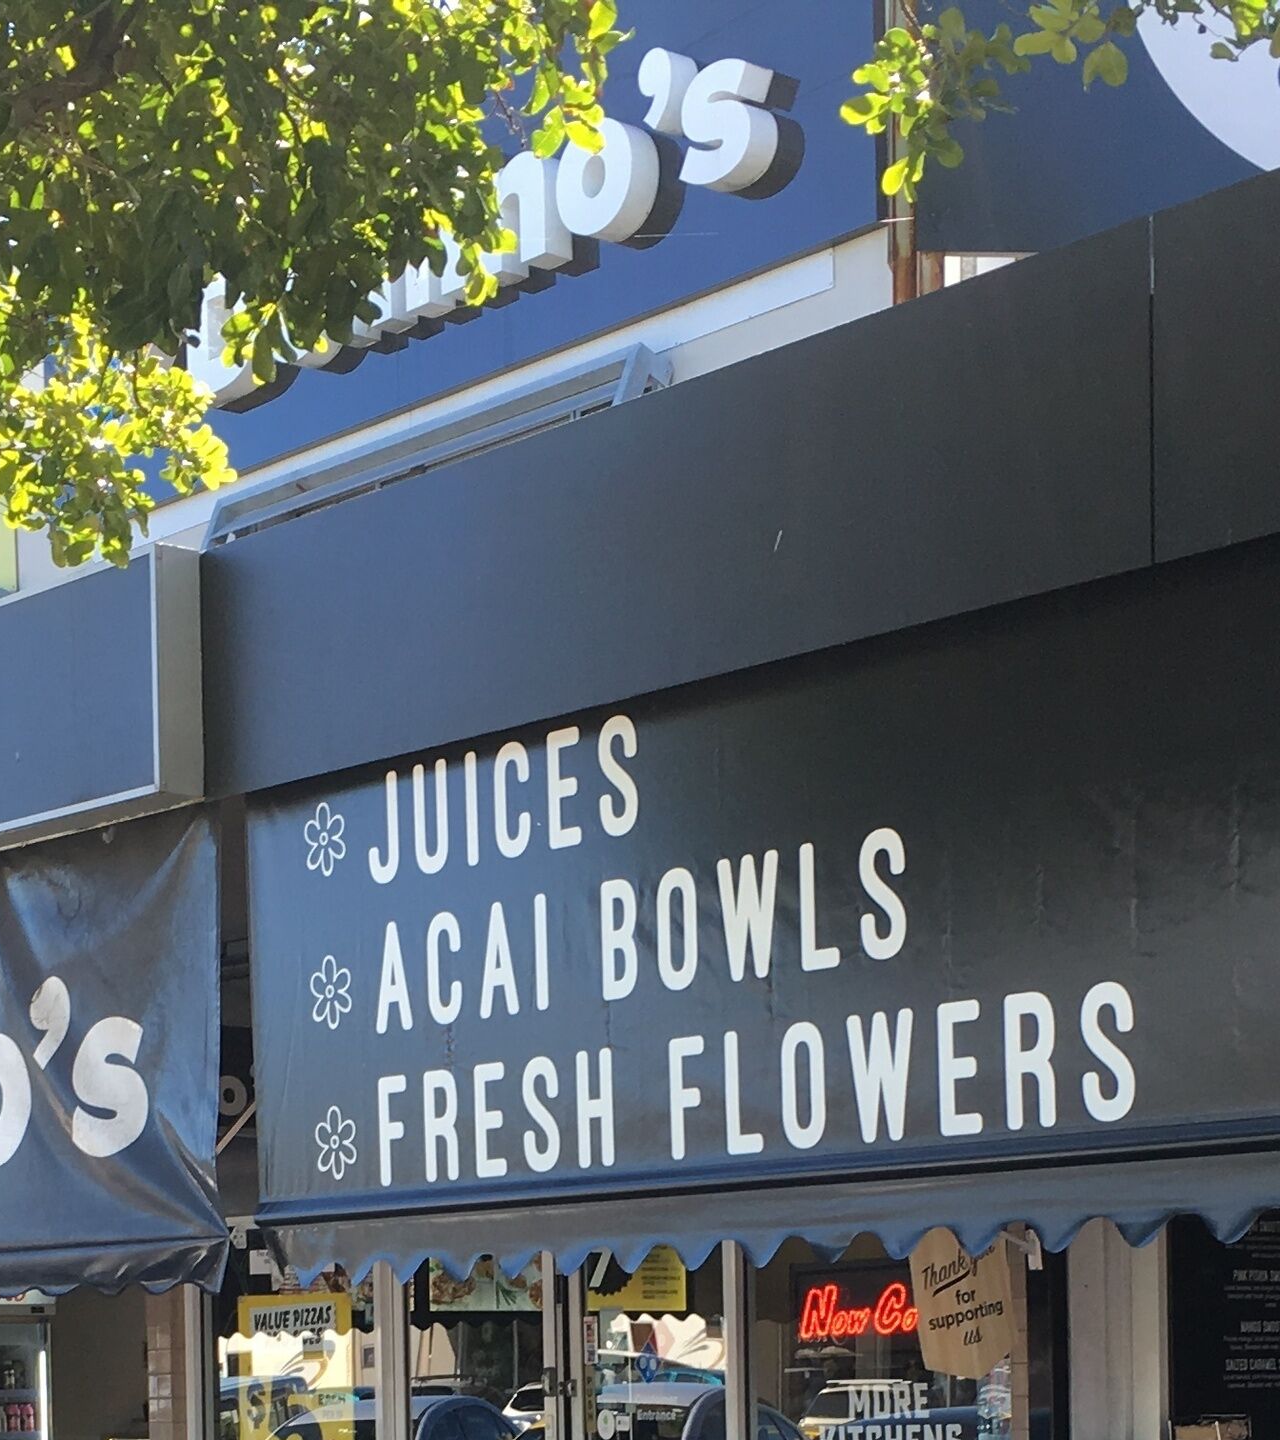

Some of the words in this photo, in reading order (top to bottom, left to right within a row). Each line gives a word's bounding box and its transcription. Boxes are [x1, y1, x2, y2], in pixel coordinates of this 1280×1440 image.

[186, 46, 782, 406] no's
[369, 714, 638, 884] JUICES
[375, 893, 549, 1034] ACAI
[601, 827, 908, 1000] BOWLS
[379, 1047, 615, 1187] FRESH
[668, 981, 1137, 1162] FLOWERS
[921, 1250, 968, 1291] Thank
[928, 1300, 1003, 1331] supporting
[956, 1289, 976, 1305] for
[254, 1310, 291, 1331] VALUE
[293, 1305, 332, 1328] PIZZAS
[962, 1327, 983, 1346] us
[637, 1409, 677, 1421] Entrance
[848, 1382, 930, 1420] MORE
